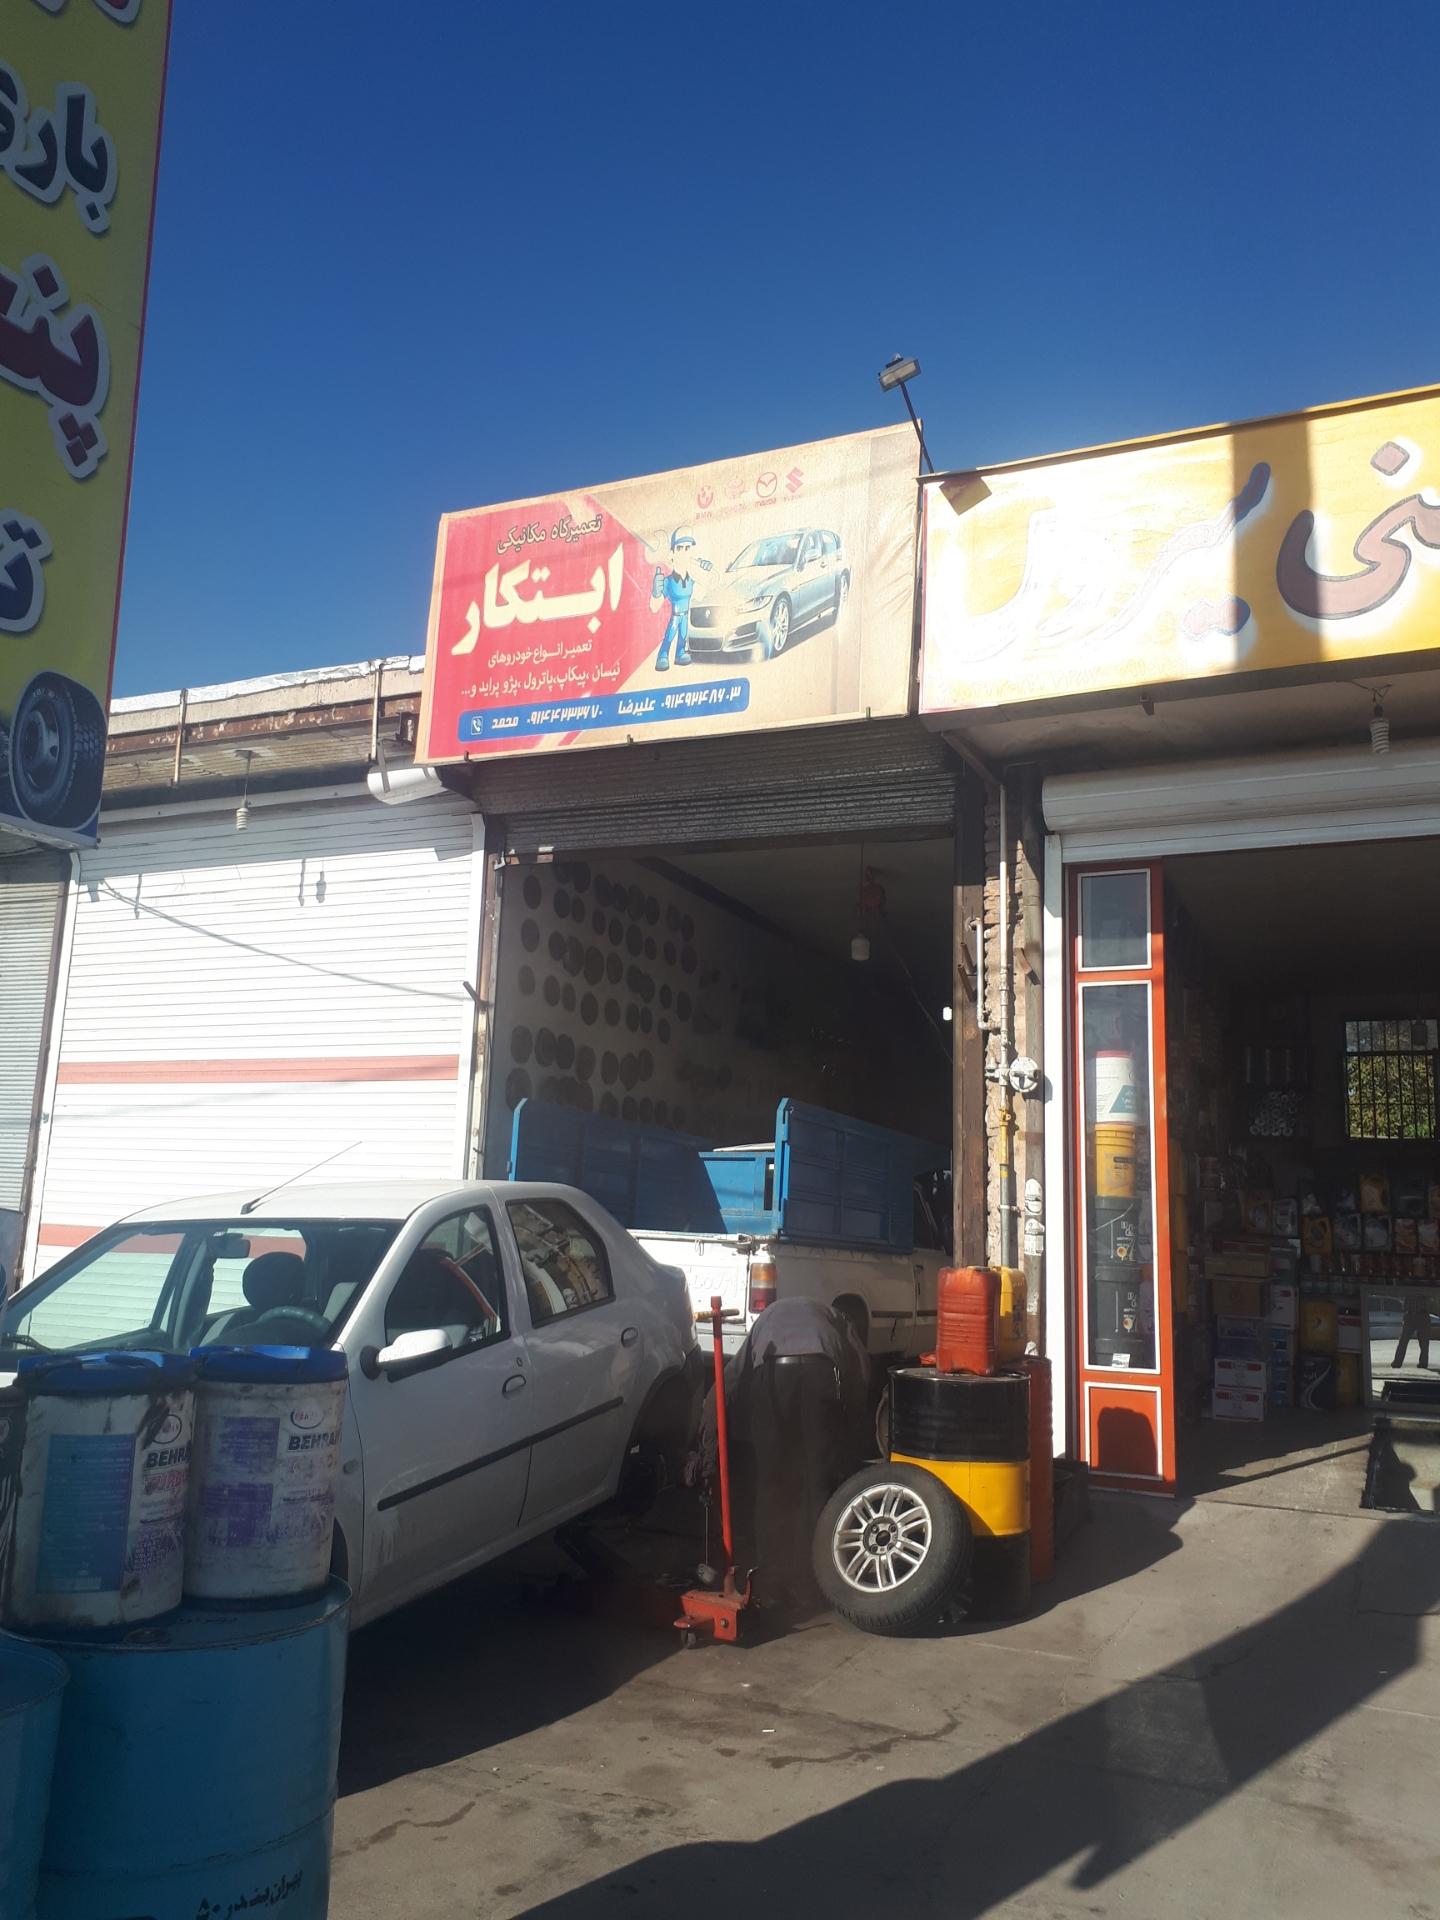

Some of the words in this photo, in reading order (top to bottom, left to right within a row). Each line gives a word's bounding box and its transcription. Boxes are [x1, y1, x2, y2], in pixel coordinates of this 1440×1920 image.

[496, 521, 547, 555] مکانیکی
[550, 513, 602, 543] تعمیرگاه
[451, 543, 624, 656] ابتکار
[487, 647, 533, 669] خودروهای
[533, 641, 564, 664] انواع
[562, 639, 592, 660] تعمیر
[478, 677, 500, 699] پراید
[617, 697, 656, 716] علیرضا
[491, 715, 519, 730] محمد
[144, 1446, 191, 1469] BEHRA
